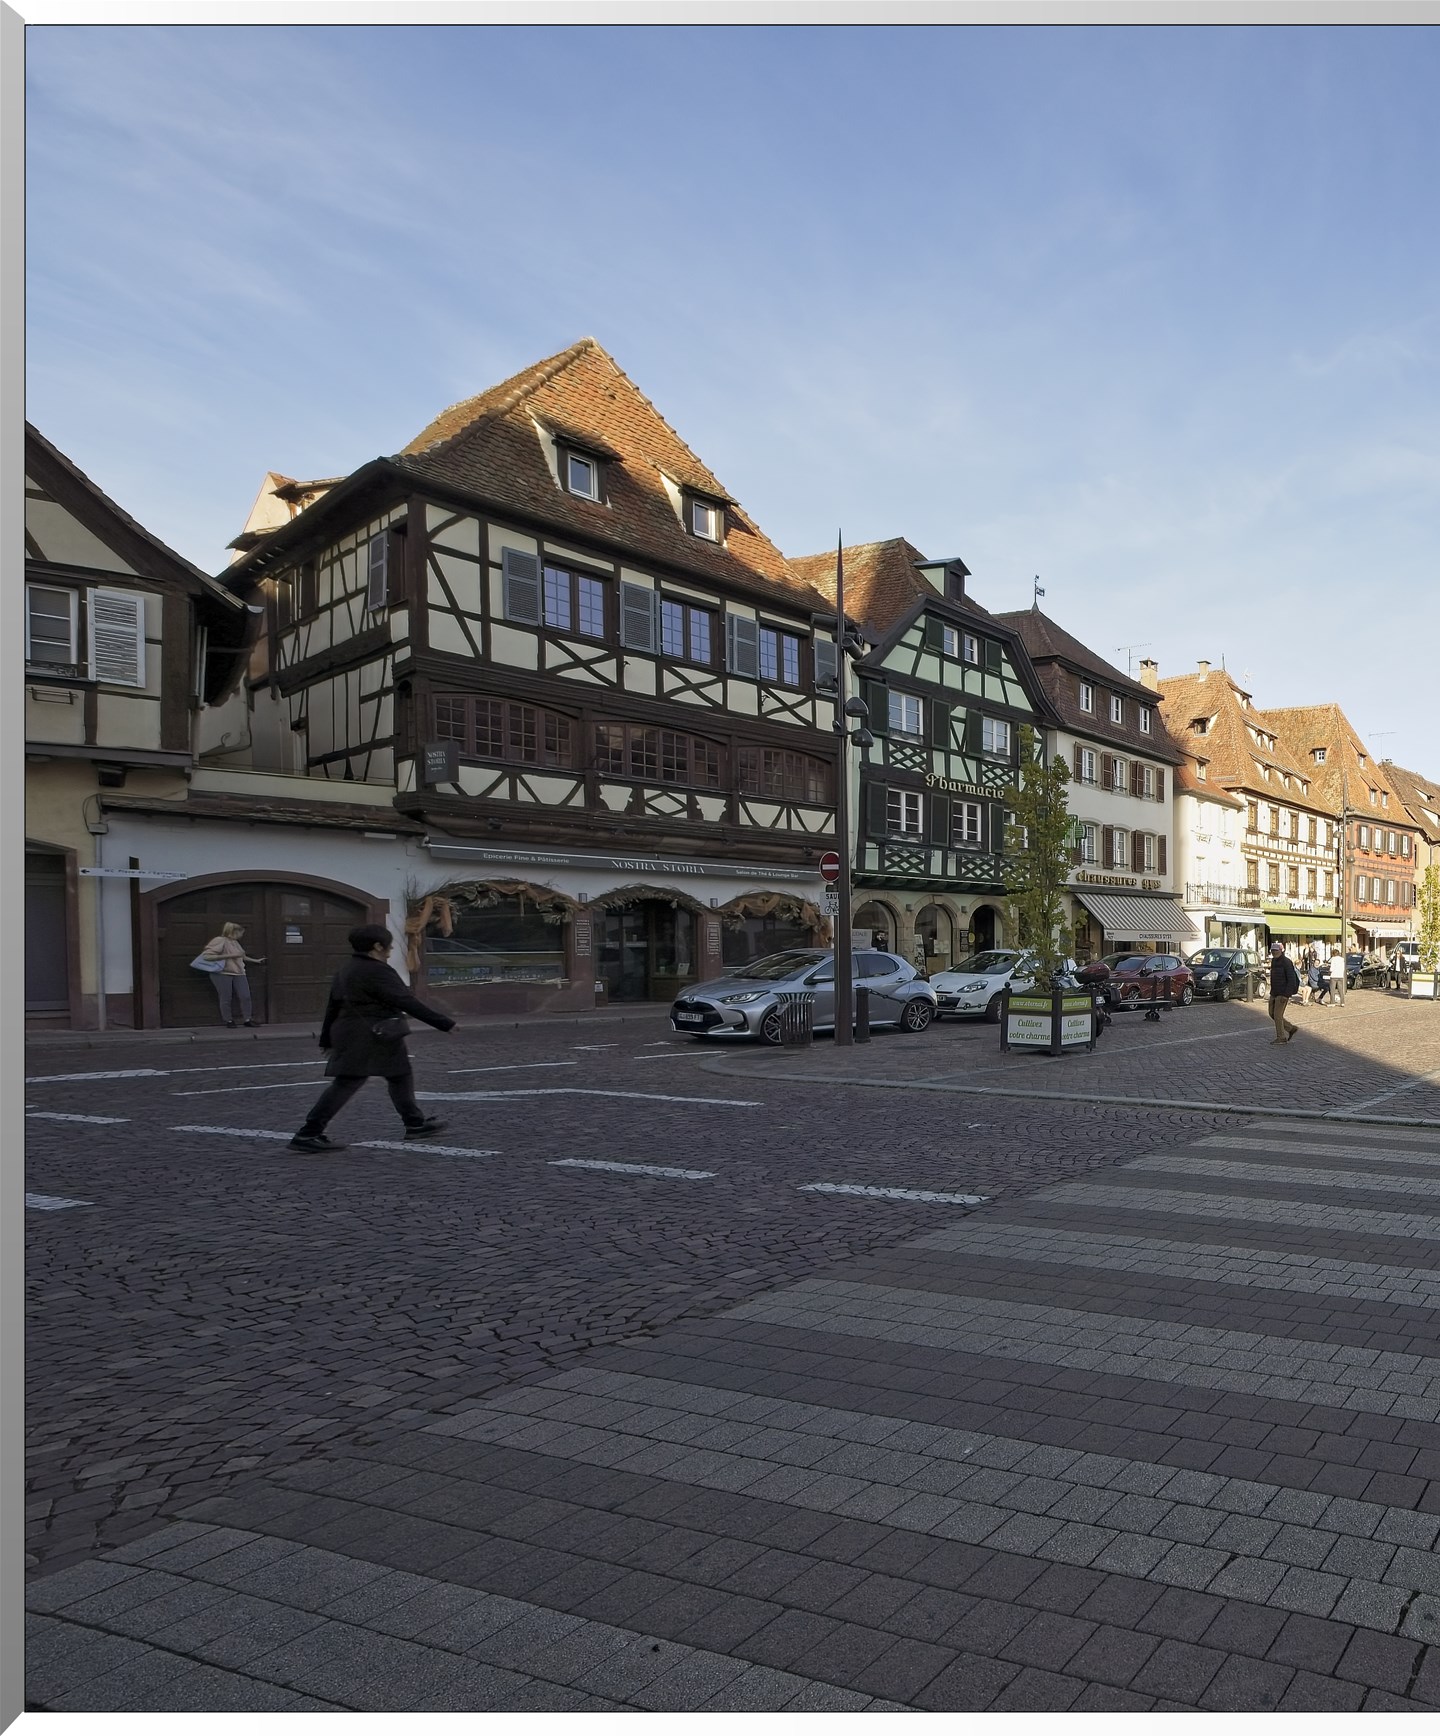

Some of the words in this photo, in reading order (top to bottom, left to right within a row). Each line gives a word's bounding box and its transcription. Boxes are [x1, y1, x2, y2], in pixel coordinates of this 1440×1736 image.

[925, 772, 1005, 799] Pharmacie
[611, 860, 656, 871] NOSTRA
[662, 863, 705, 874] STORIA
[1018, 1019, 1043, 1028] Cultivez
[1008, 1031, 1025, 1039] votre
[1025, 1032, 1051, 1041] charme
